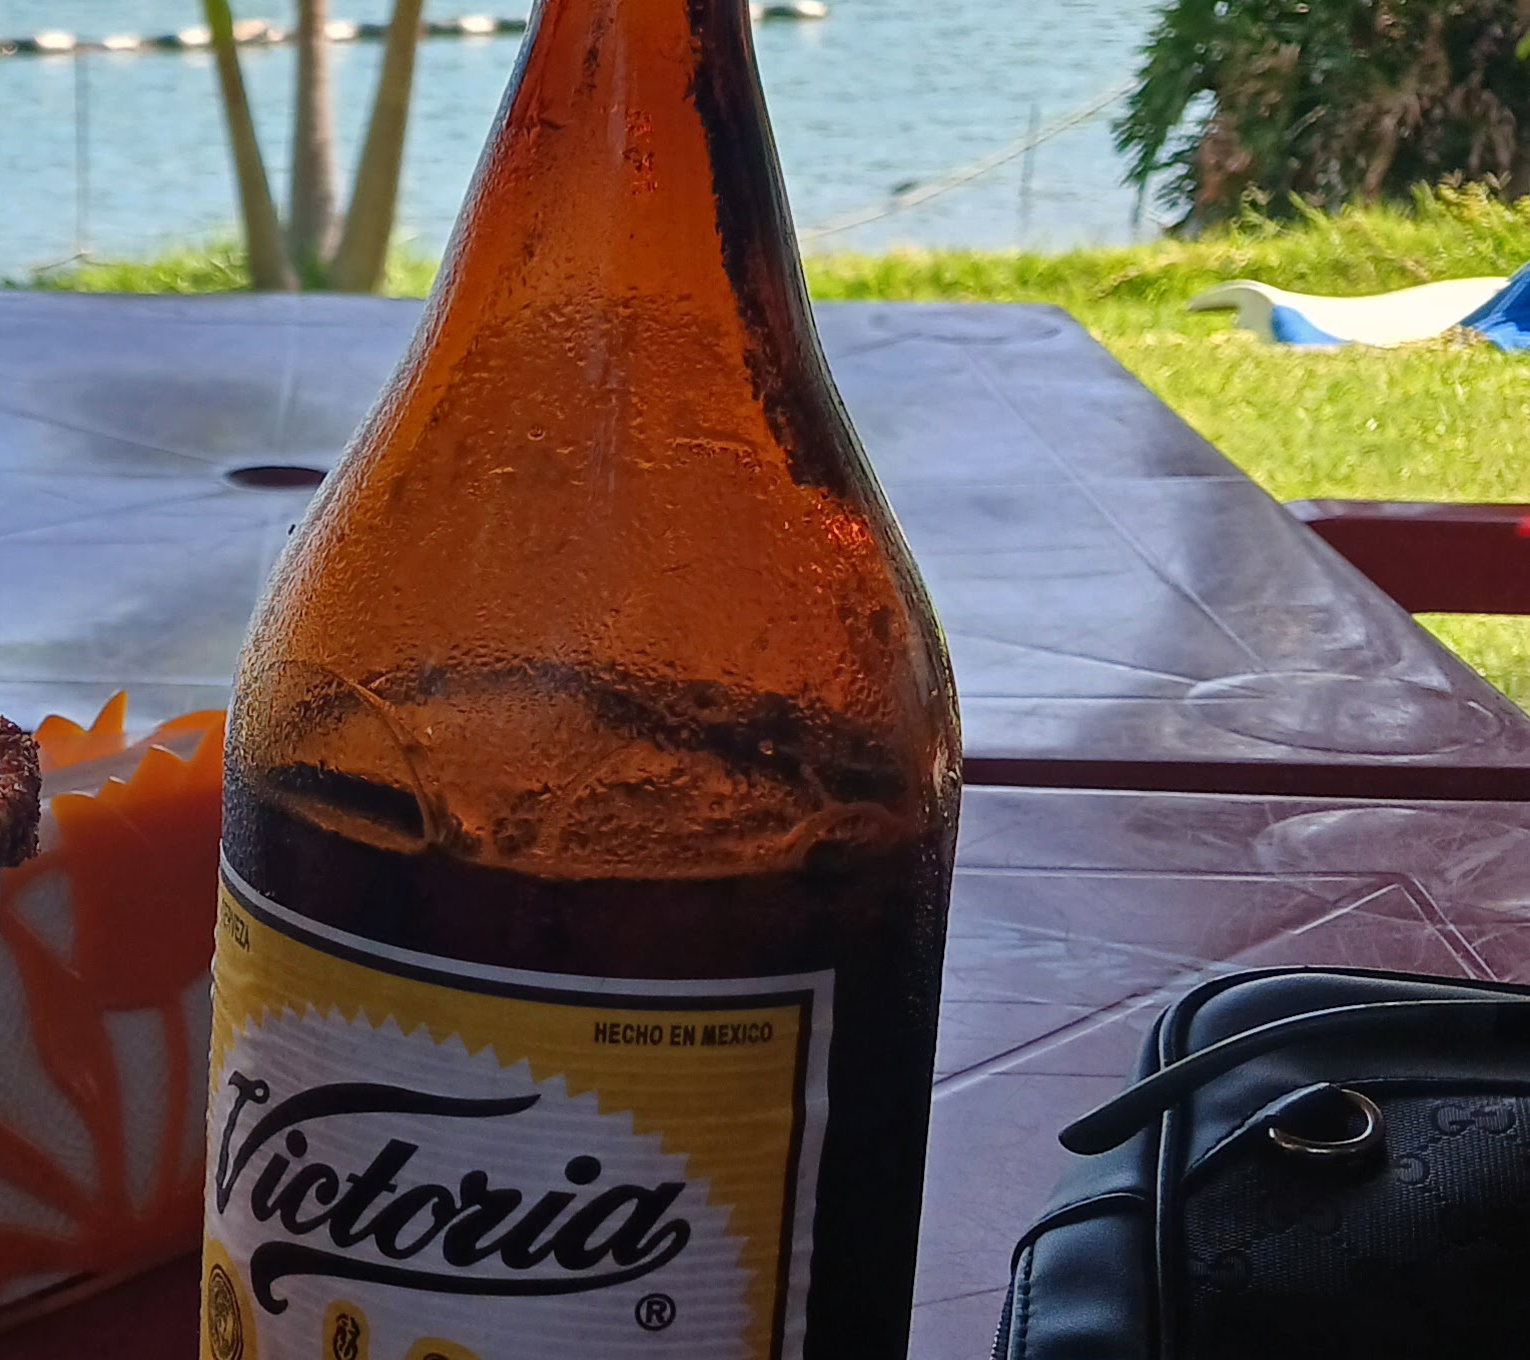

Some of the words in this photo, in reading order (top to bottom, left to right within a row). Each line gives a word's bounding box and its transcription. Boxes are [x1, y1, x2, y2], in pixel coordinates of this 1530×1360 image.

[594, 1022, 663, 1046] HECHO
[670, 1025, 695, 1046] EN
[700, 1022, 773, 1047] MEXICO
[217, 1070, 692, 1316] Victoria
